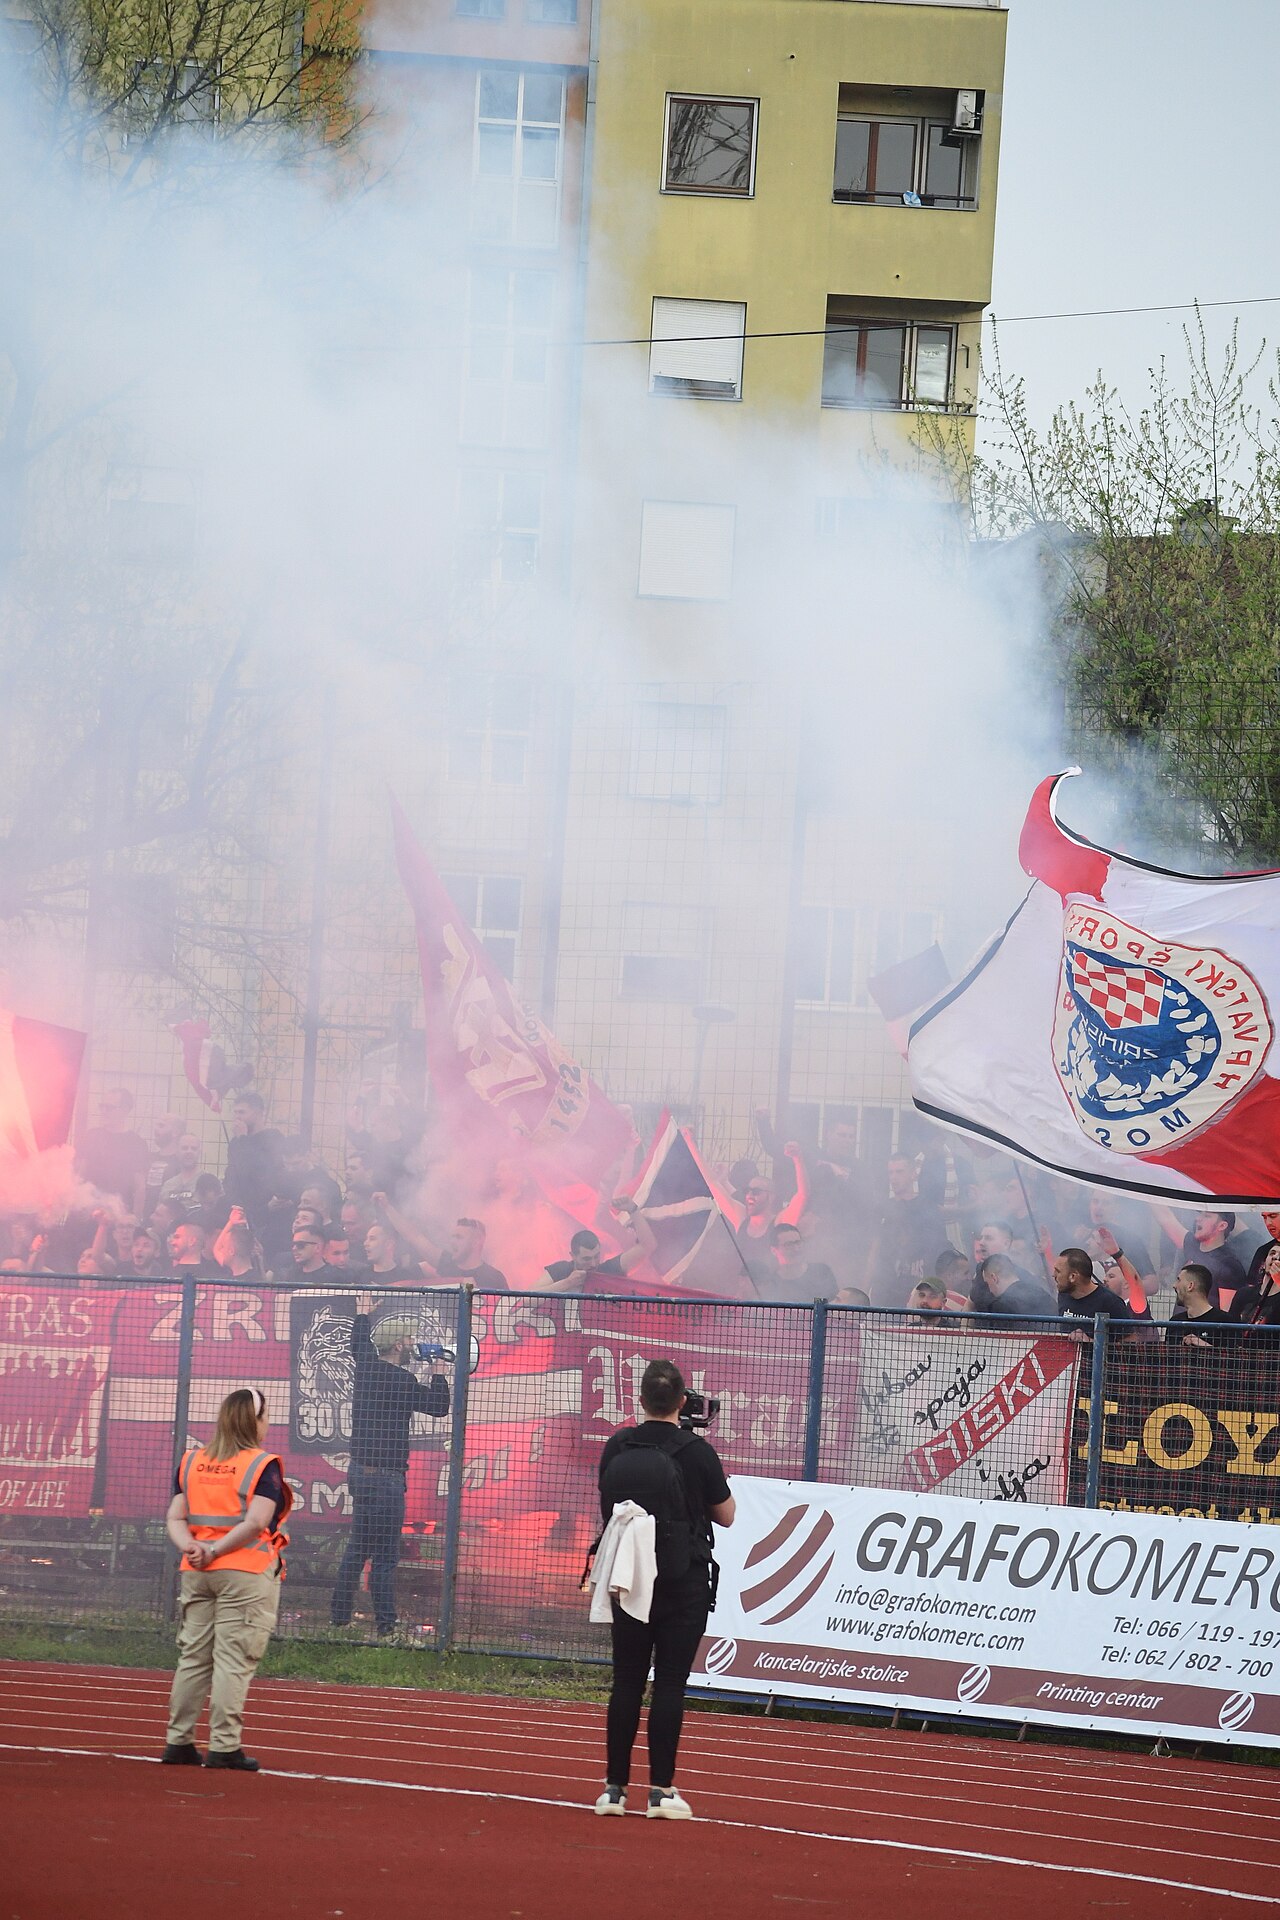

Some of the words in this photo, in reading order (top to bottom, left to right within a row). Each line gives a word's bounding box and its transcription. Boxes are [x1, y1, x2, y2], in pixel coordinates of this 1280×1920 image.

[1, 1292, 93, 1338] RAS
[914, 1358, 987, 1430] spaja
[196, 1463, 237, 1475] OMEGA
[0, 1479, 26, 1507] OF
[24, 1481, 70, 1509] LIFE
[835, 1584, 1037, 1623] info@grafokomerc.com
[826, 1616, 1025, 1651] www.grafokomerc.com
[1113, 1616, 1143, 1635] Tel:
[1146, 1619, 1182, 1638] 066
[1197, 1623, 1235, 1643] 119
[1249, 1629, 1280, 1649] 197
[753, 1651, 857, 1678] Kancelarijske
[857, 1659, 910, 1684] stolice
[1101, 1645, 1131, 1664] Tel:
[1134, 1648, 1167, 1667] 062
[1184, 1653, 1222, 1672] 802
[1237, 1658, 1274, 1678] 700
[1036, 1681, 1105, 1709] Printing
[1105, 1691, 1164, 1710] centar
